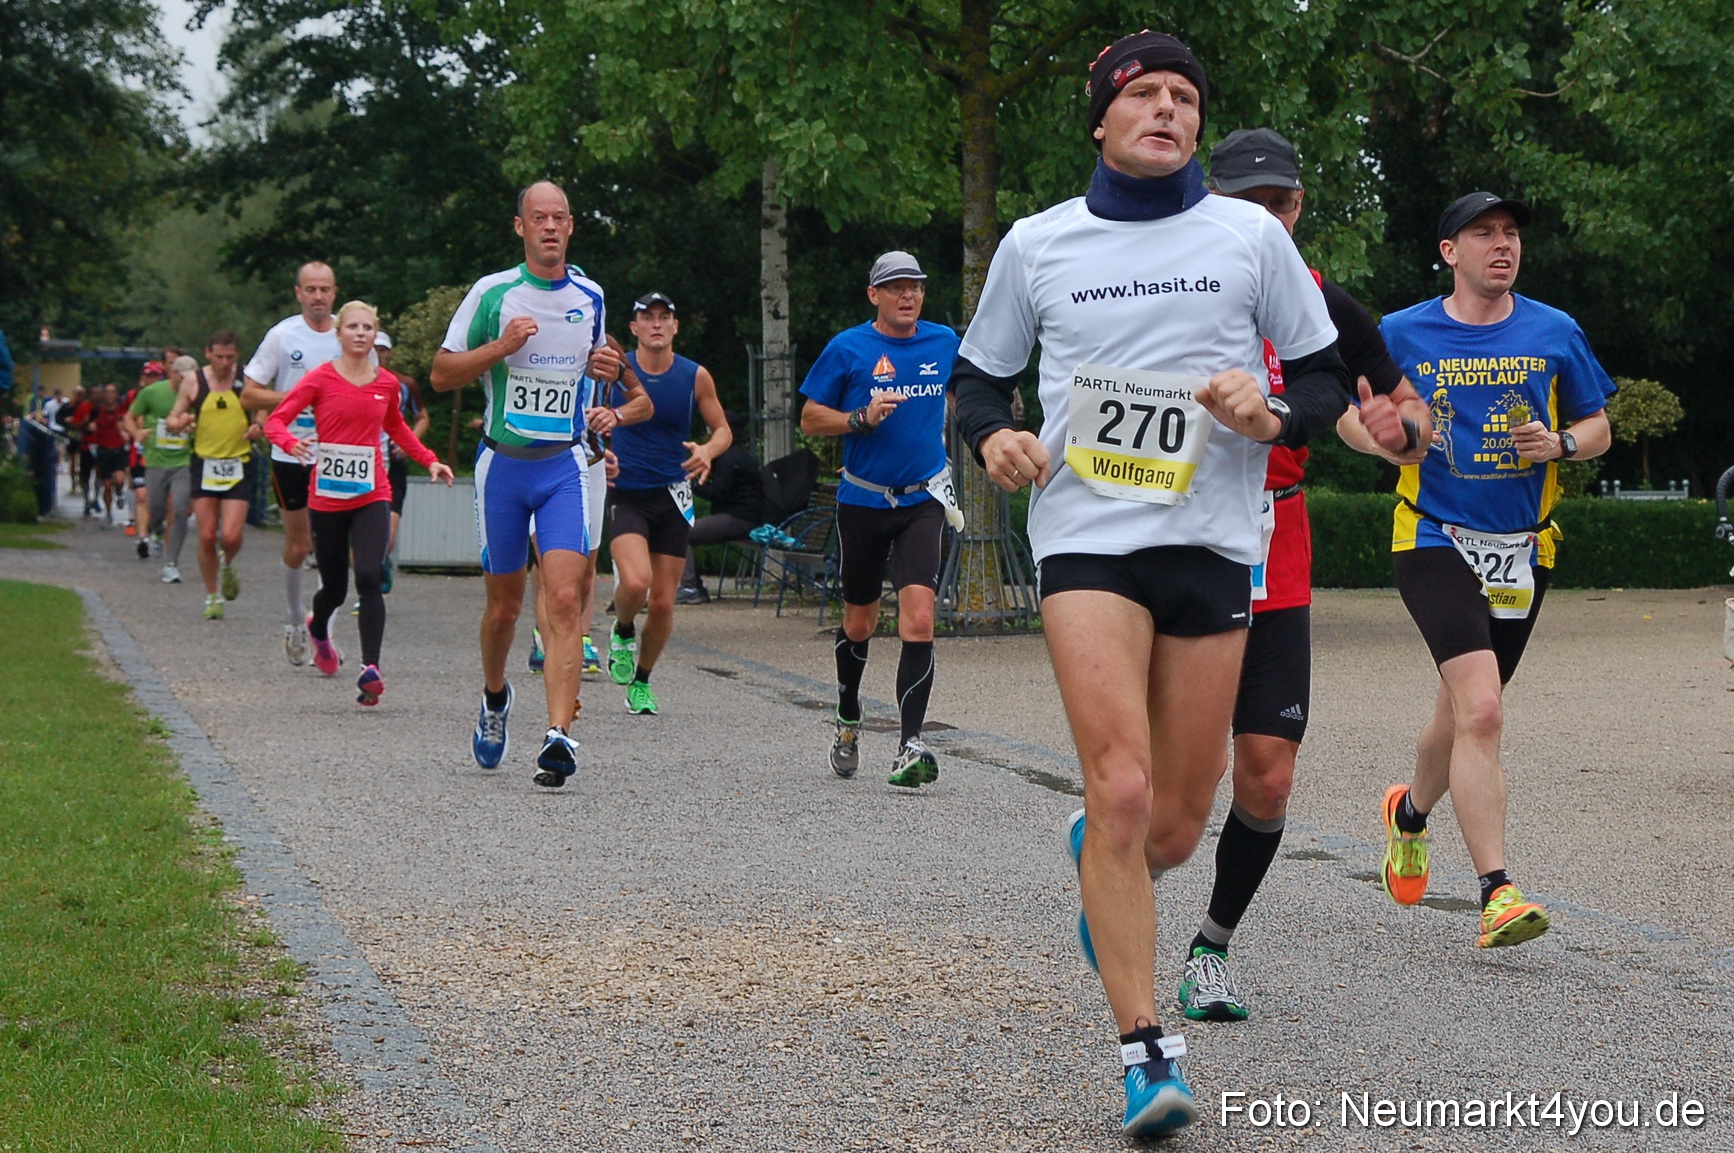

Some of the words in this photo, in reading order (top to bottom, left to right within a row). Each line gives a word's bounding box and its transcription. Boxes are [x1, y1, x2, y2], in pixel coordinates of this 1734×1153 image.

[1071, 276, 1221, 304] www.hasit.de
[529, 353, 576, 365] Gerhard
[1416, 361, 1436, 377] 10.
[1438, 356, 1547, 373] NEUMARKTER
[509, 373, 533, 383] PARTL
[1073, 375, 1121, 393] PARTL
[1124, 382, 1192, 401] Neumarkt
[1435, 371, 1528, 387] STADTLAUF
[513, 385, 571, 415] 3120
[1096, 399, 1186, 454] 270
[322, 457, 369, 479] 2649
[1092, 456, 1176, 489] Wolfgang
